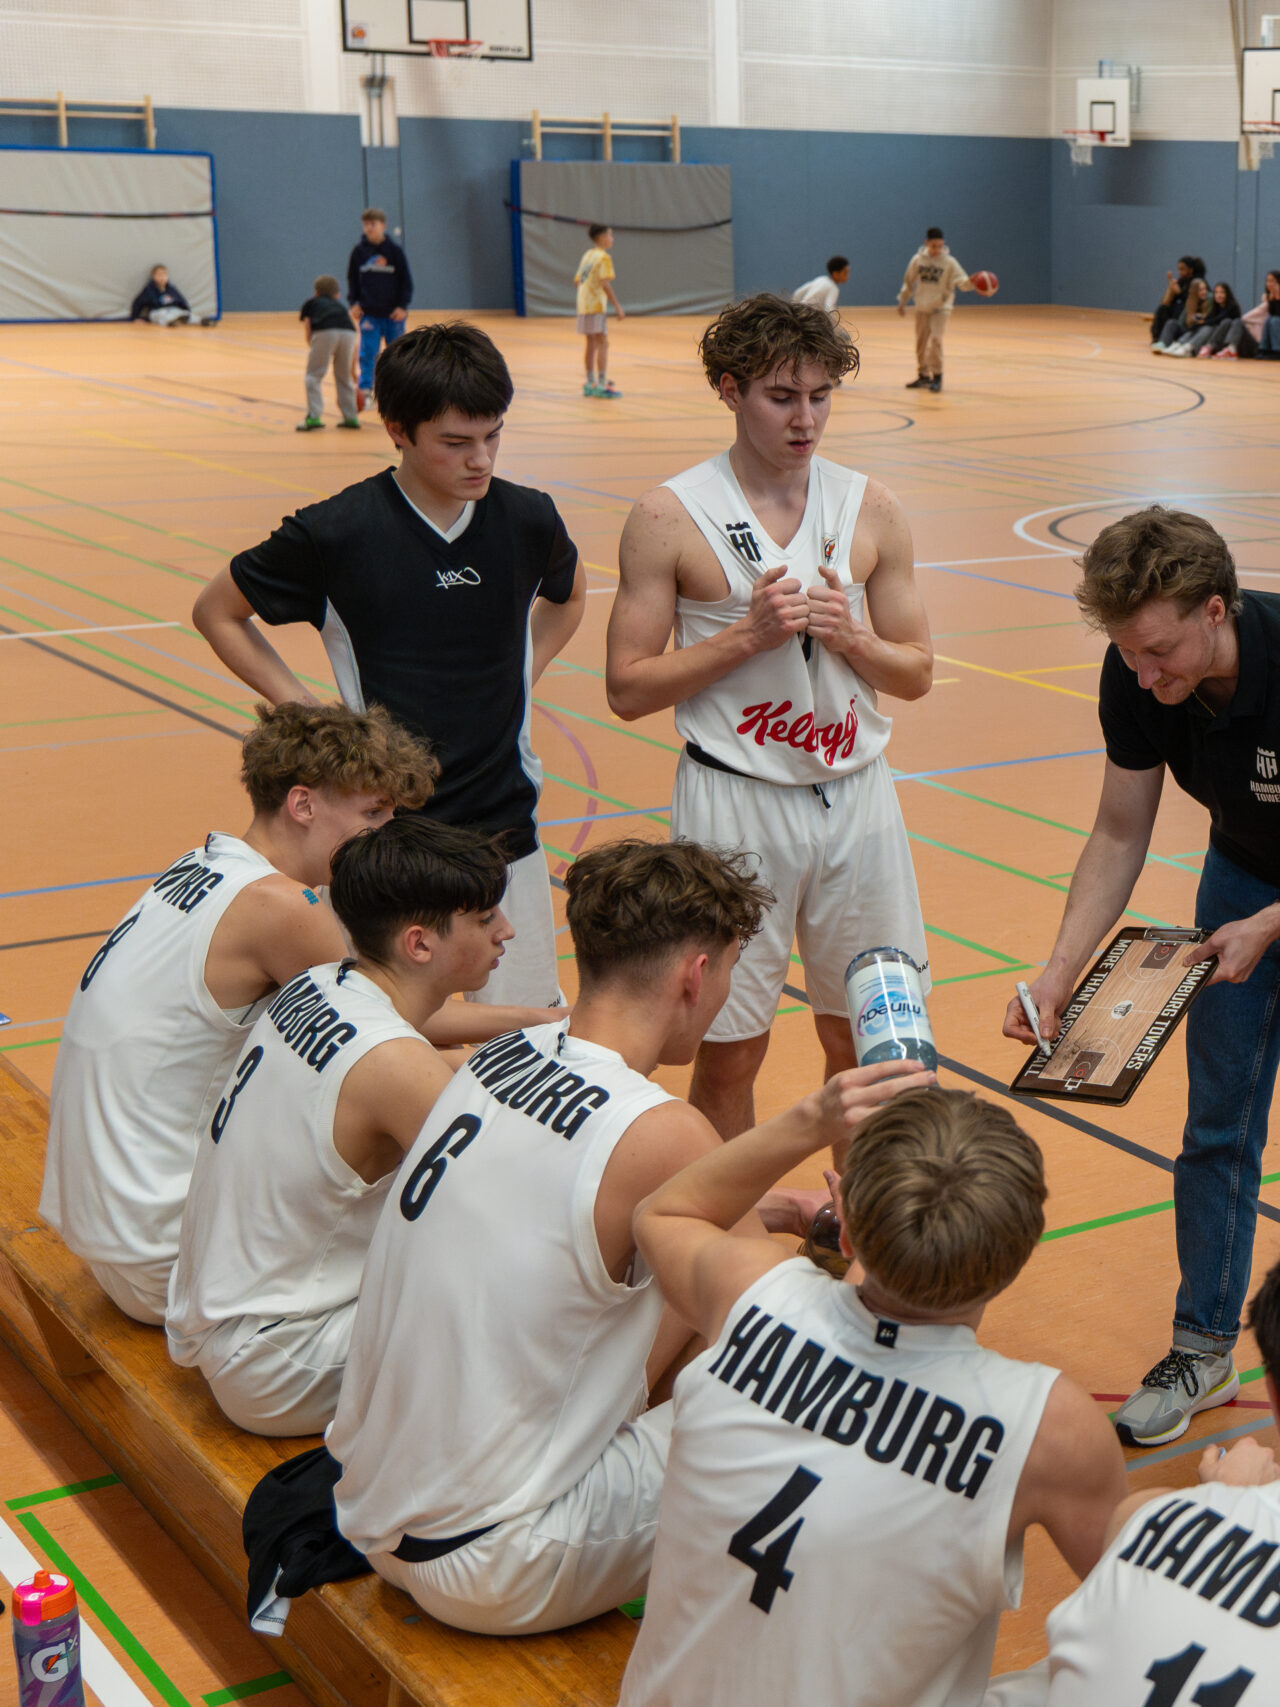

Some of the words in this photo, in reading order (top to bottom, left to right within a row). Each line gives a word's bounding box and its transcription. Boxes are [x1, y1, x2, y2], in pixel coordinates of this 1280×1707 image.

[81, 911, 142, 992] 8
[1076, 972, 1109, 1001] THAN
[1099, 940, 1132, 969] MORE
[1160, 961, 1212, 1017] HAMBURG
[1126, 1020, 1171, 1070] TOWERS
[211, 1045, 264, 1144] 3
[400, 1113, 482, 1221] 6
[708, 1304, 1005, 1500] HAMBURG
[727, 1464, 823, 1614] 4
